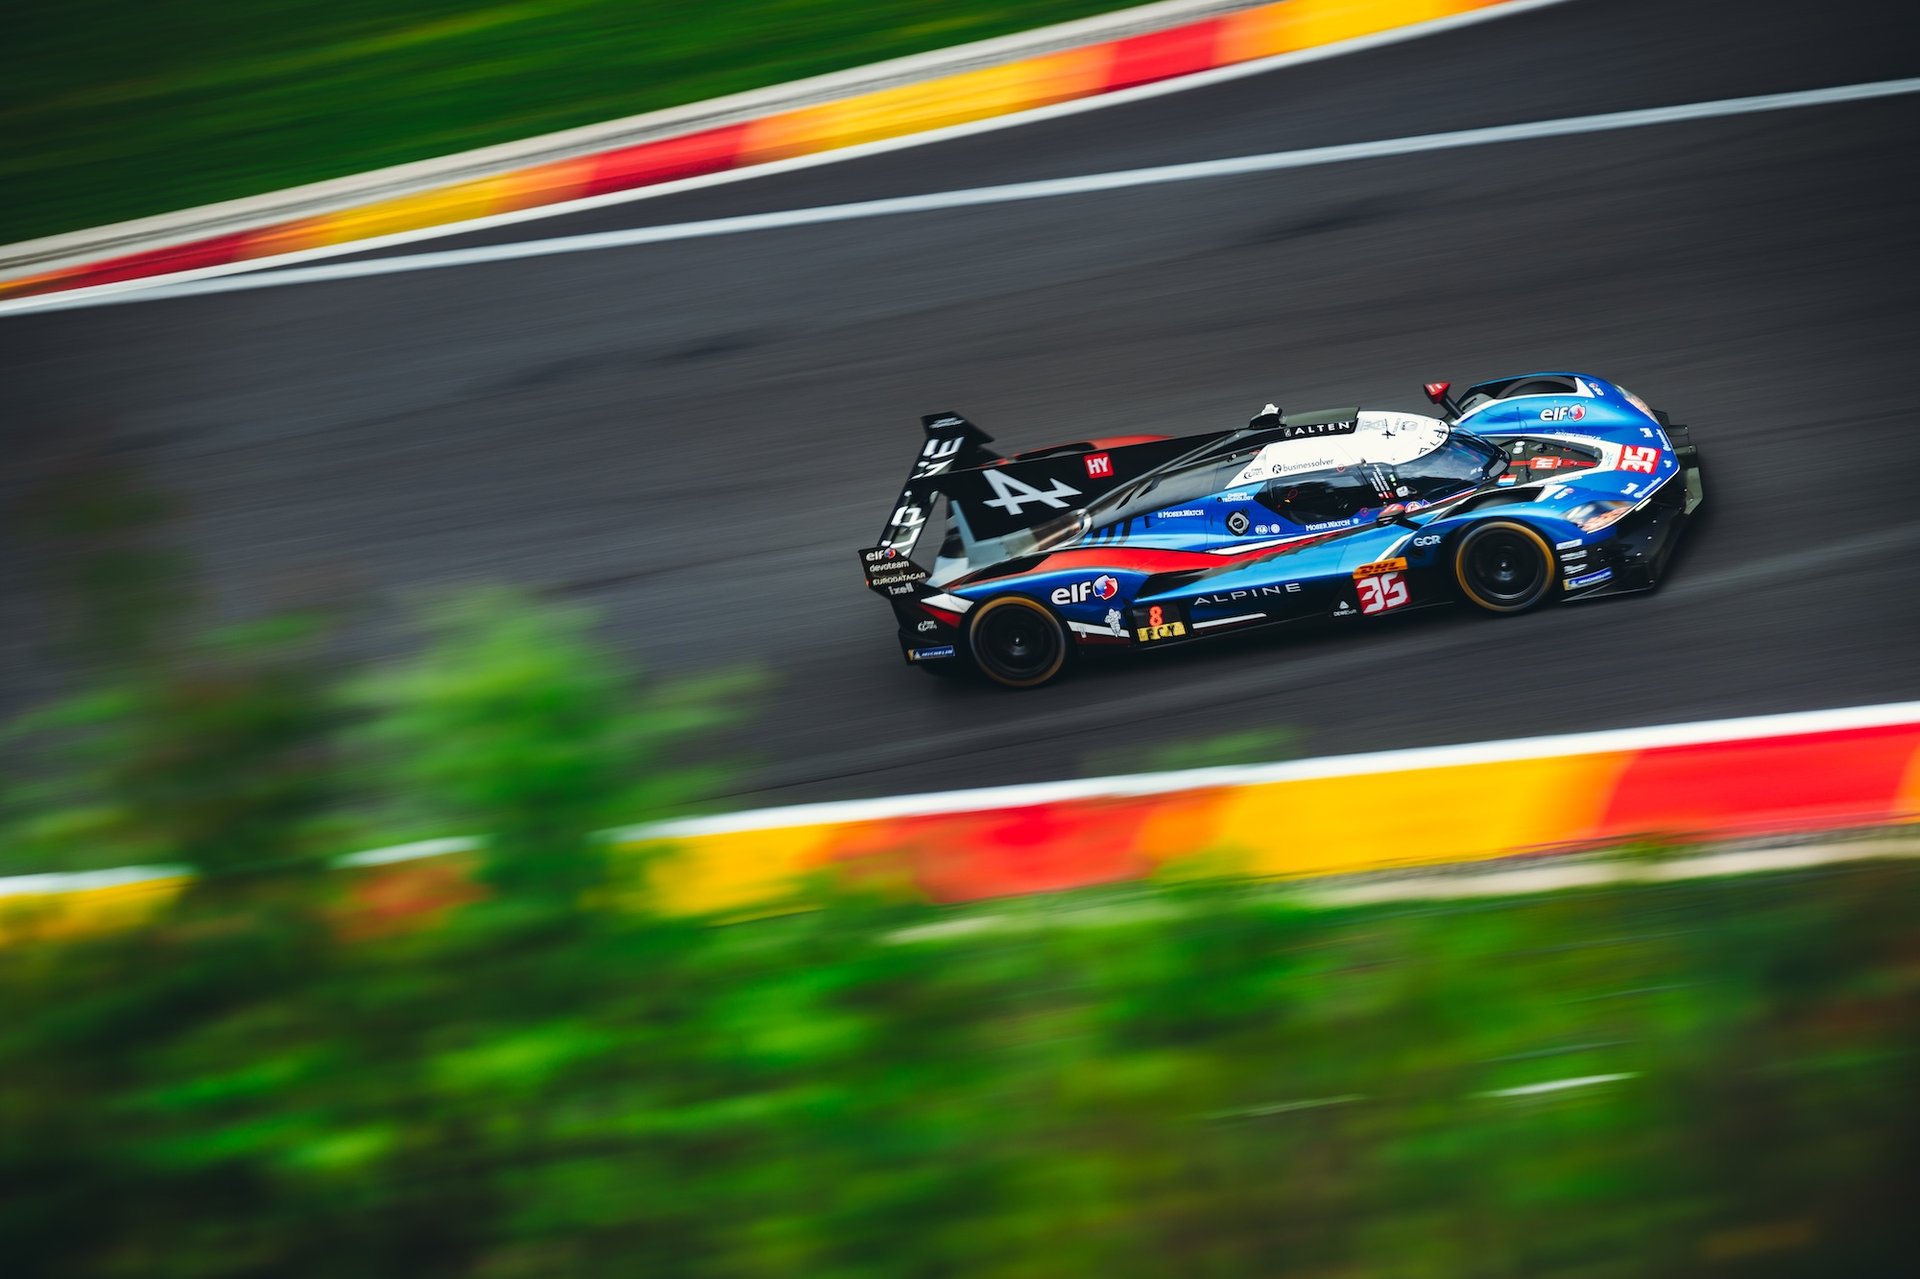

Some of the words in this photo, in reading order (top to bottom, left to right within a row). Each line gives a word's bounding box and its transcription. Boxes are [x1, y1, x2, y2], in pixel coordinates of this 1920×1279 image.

[1540, 407, 1569, 421] elf
[1294, 421, 1350, 435] ALTEN
[1086, 456, 1109, 475] HY
[1283, 457, 1334, 472] businessolver
[1620, 445, 1658, 474] 35
[1413, 535, 1442, 547] GCR
[865, 550, 885, 561] elf
[869, 560, 910, 573] devoteam
[1360, 561, 1401, 574] DHL
[1051, 581, 1092, 605] elf
[1193, 582, 1302, 606] ALPINE
[1356, 572, 1409, 614] 35
[1148, 605, 1164, 627] 8
